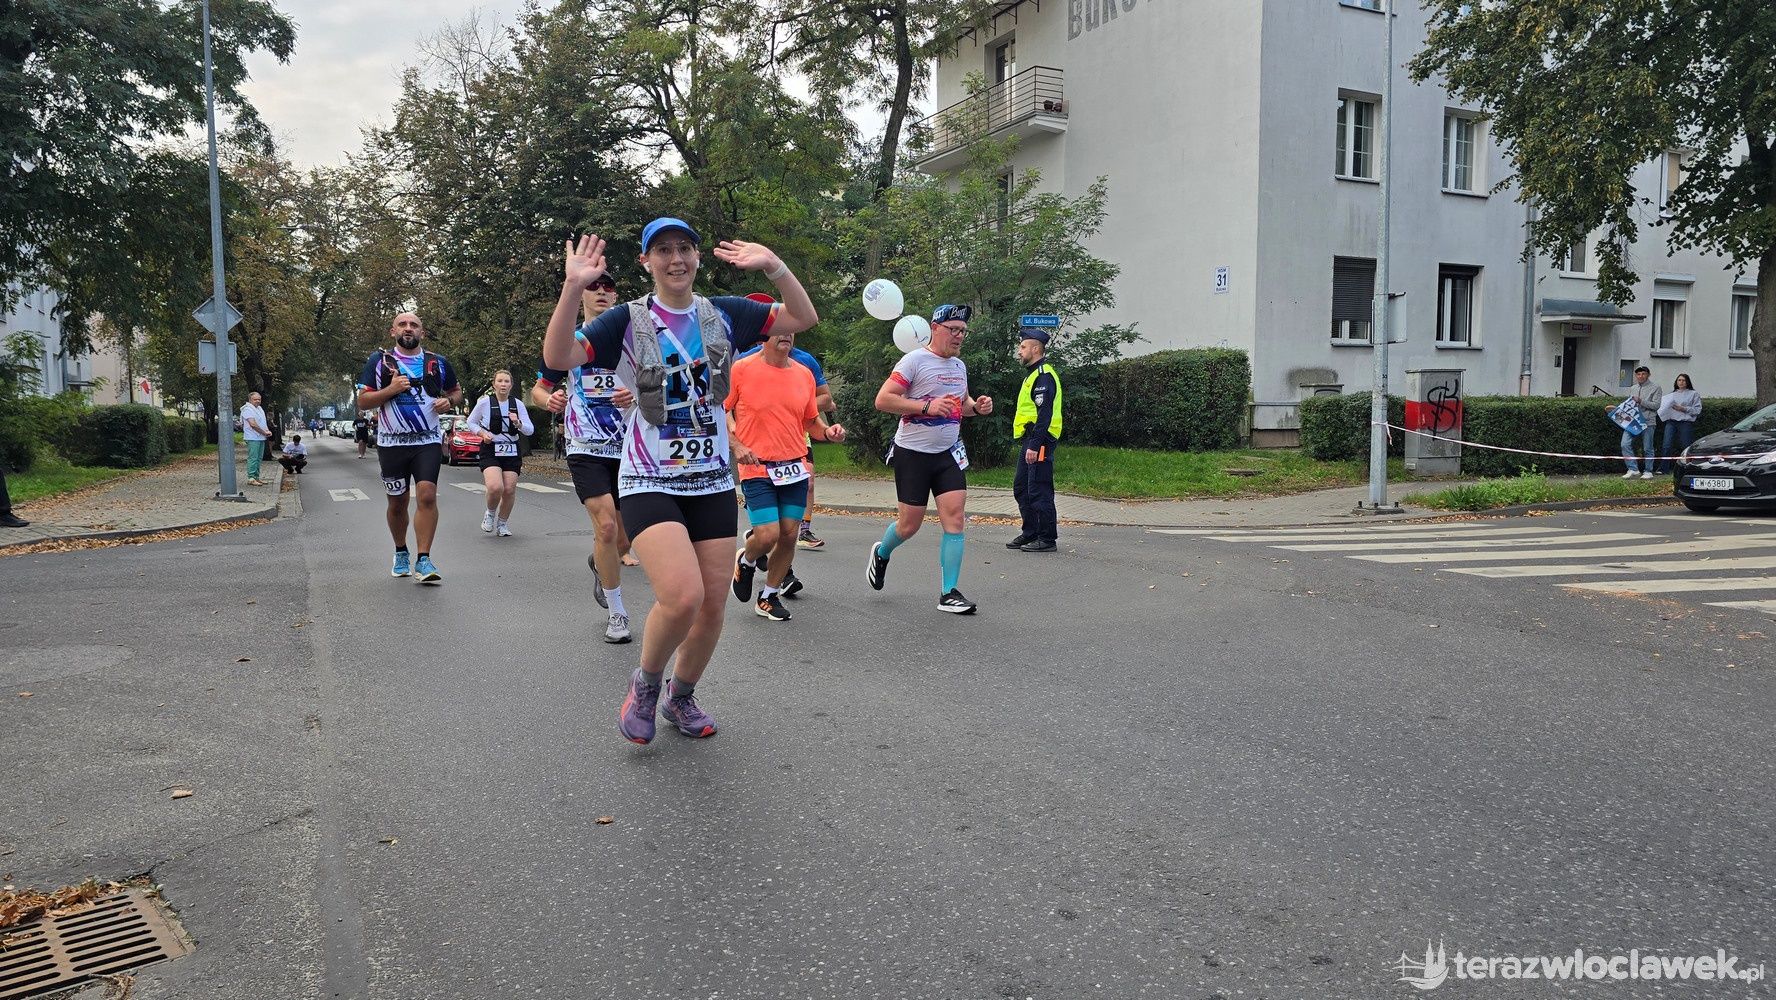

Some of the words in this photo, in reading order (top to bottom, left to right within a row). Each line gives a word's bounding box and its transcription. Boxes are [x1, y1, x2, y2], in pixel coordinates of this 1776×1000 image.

[1217, 273, 1227, 287] 31
[593, 375, 616, 389] 28
[499, 444, 513, 453] 271
[669, 438, 714, 460] 298
[774, 464, 801, 479] 640
